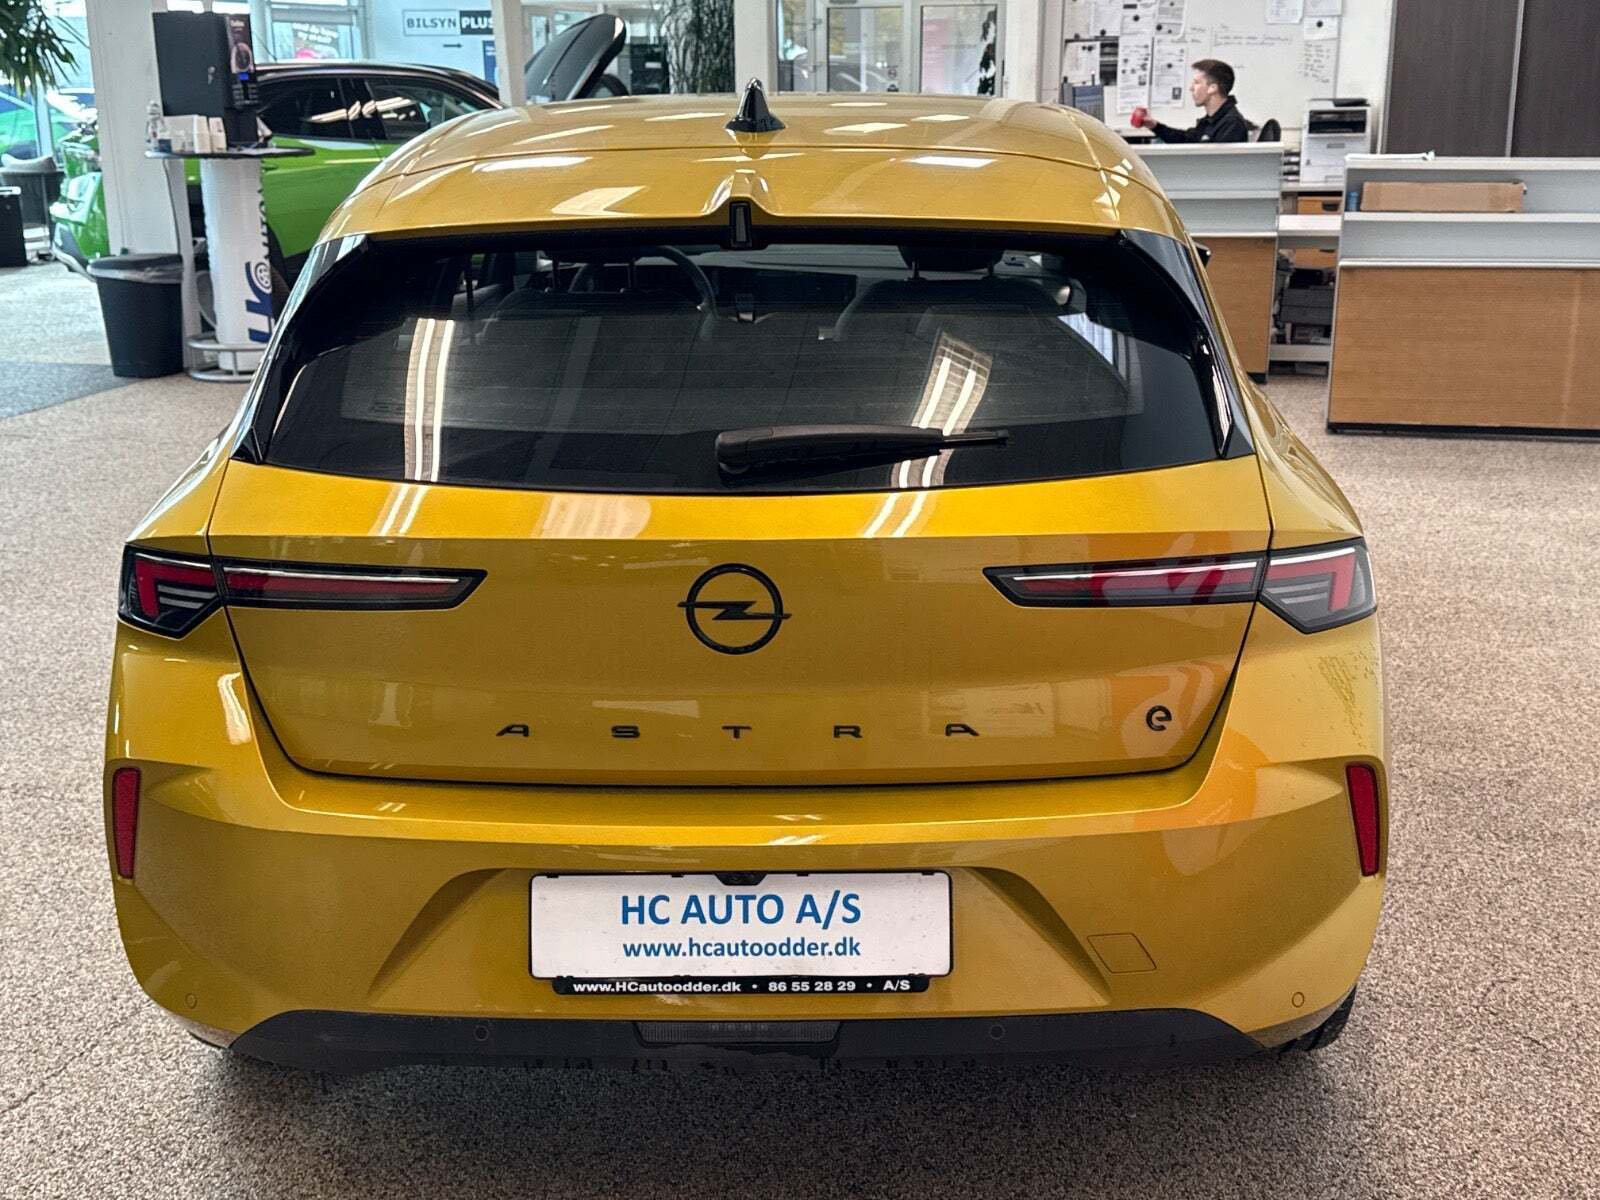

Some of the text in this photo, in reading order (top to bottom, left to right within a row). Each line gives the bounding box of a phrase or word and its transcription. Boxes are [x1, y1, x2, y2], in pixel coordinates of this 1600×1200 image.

[406, 18, 457, 29] BILSYN
[1145, 705, 1172, 732] e
[495, 723, 980, 740] ASTRA
[620, 889, 862, 929] HC AUTO A/S
[623, 937, 861, 958] www.hcautoodder.dk
[572, 979, 911, 993] www.HCautoodder.dk 86 55 28 29 A/S
